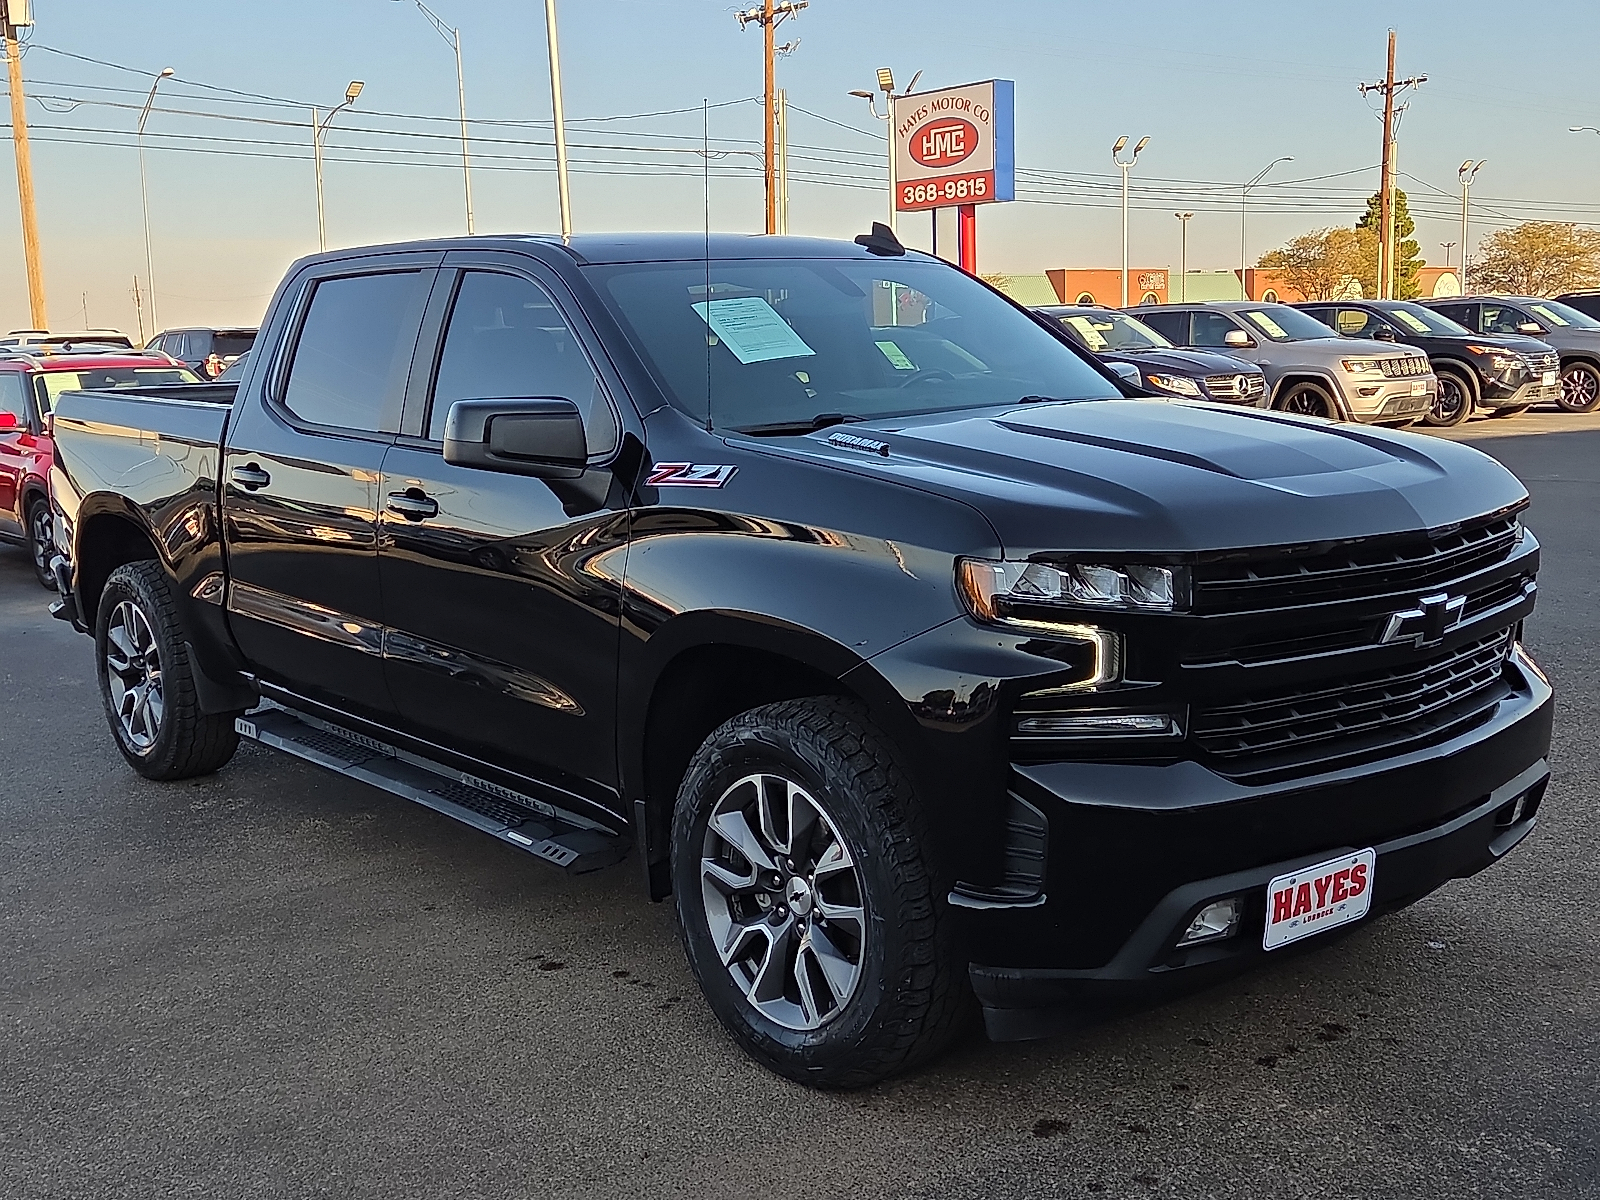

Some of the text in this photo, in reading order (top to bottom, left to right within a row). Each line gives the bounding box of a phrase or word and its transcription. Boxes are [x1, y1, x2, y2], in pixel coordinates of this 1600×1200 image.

[898, 97, 990, 138] HAYES MOTOR CO.
[922, 124, 965, 161] HMC
[903, 177, 987, 203] 368-9815
[643, 461, 738, 488] Z71
[1272, 863, 1368, 924] HAYES
